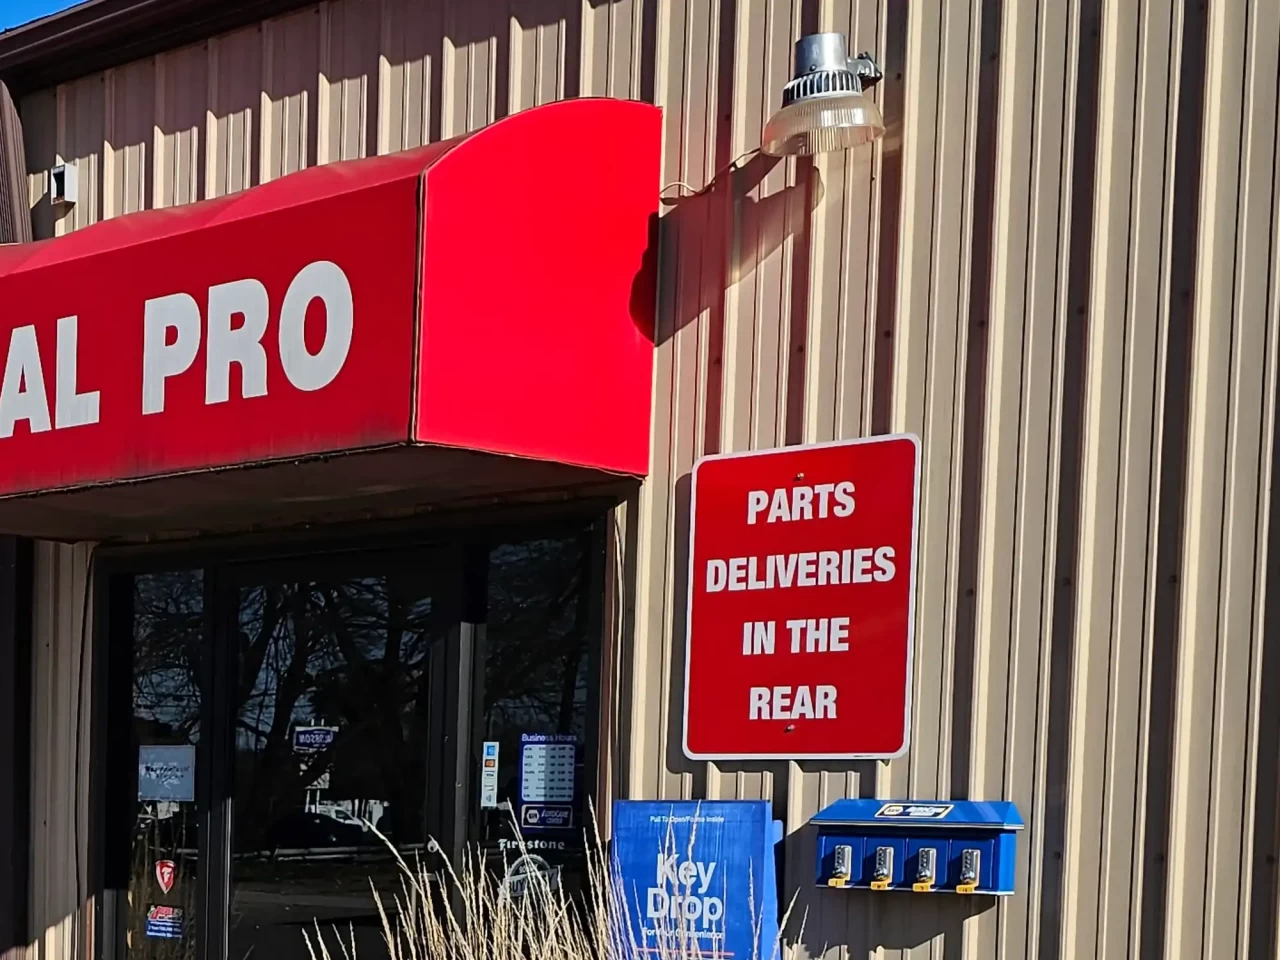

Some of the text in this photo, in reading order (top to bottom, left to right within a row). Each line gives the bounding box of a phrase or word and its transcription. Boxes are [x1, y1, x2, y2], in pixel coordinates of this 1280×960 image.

[142, 260, 354, 415] PRO
[747, 481, 855, 525] PARTS
[706, 546, 896, 592] DELIVERIES
[742, 617, 850, 655] IN THE
[748, 685, 838, 720] REAR
[521, 732, 554, 742] Business
[657, 854, 717, 894] Key
[647, 887, 723, 928] Drop
